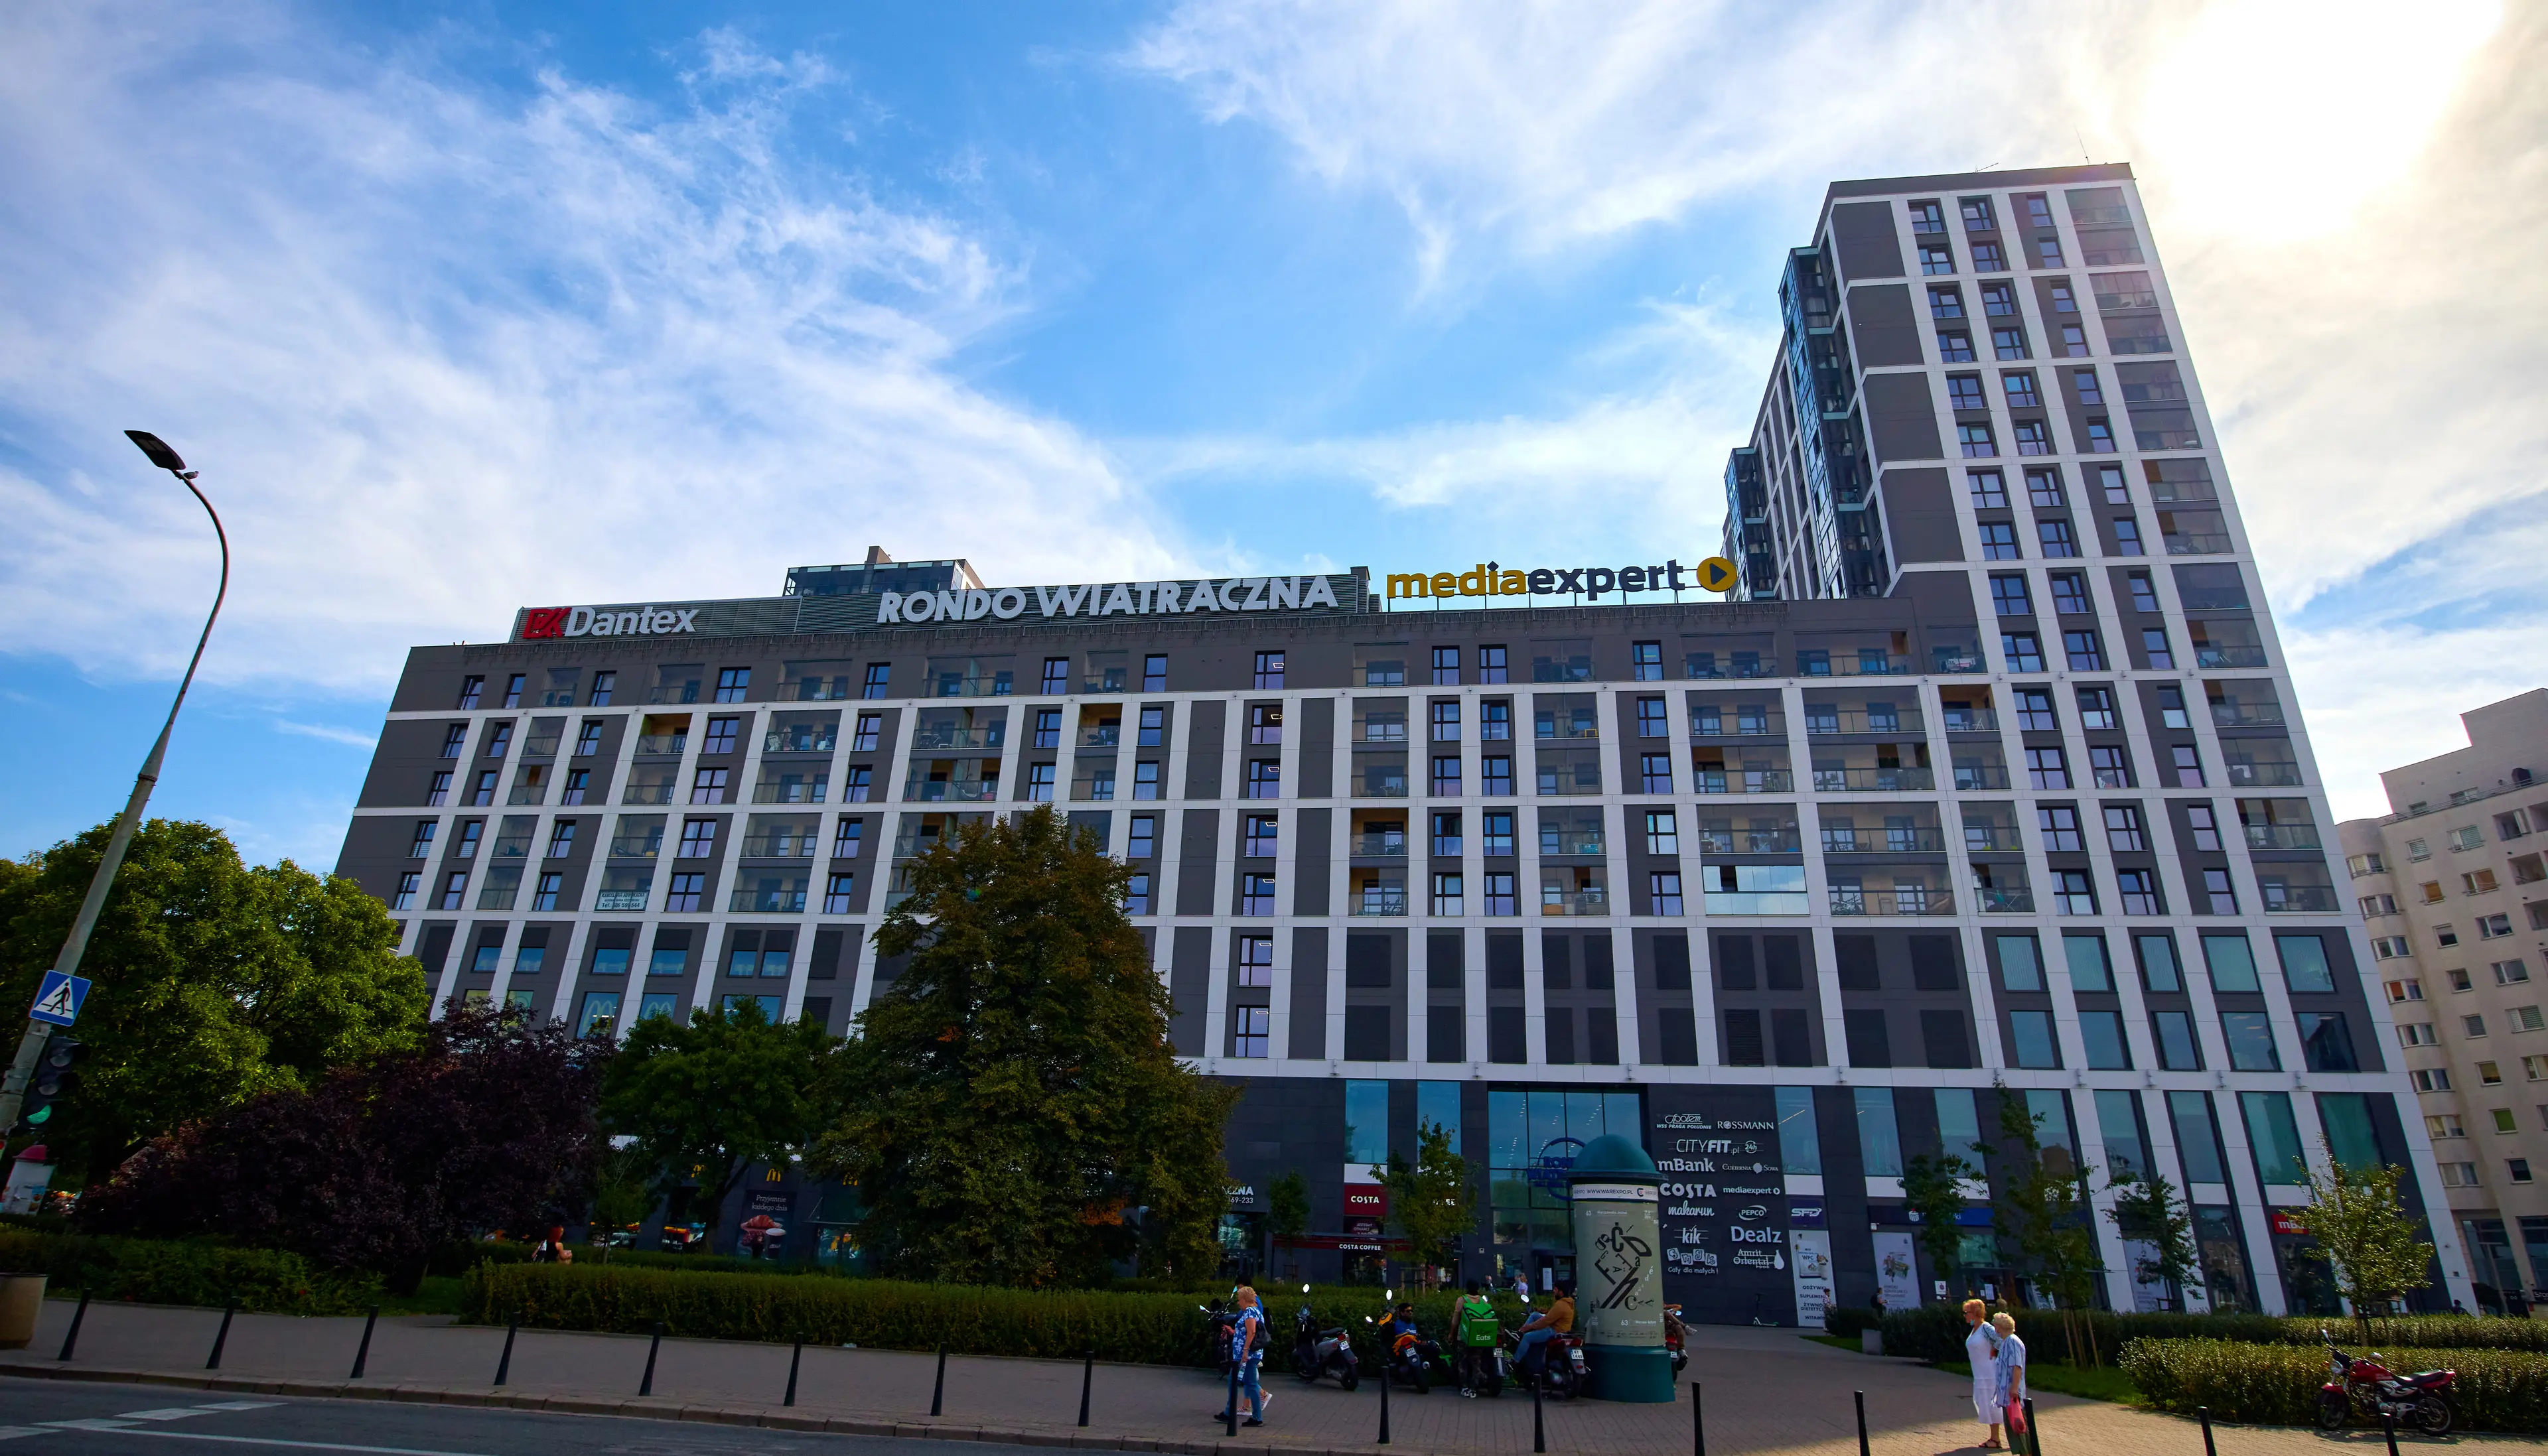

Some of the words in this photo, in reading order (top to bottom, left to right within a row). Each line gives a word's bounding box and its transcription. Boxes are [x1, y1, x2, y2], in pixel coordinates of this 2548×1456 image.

[1386, 559, 1685, 600] mediaexpert
[877, 587, 1027, 625] RONDO
[1034, 575, 1340, 617] WIATRACZNA
[565, 606, 700, 637] Dantex
[1717, 1120, 1774, 1130] ROSSMANN
[1658, 1158, 1715, 1172] mBank
[1660, 1183, 1717, 1199] COSTA
[1723, 1186, 1772, 1195] mediaexpert
[756, 1194, 787, 1203] Przyjemnie
[1351, 1195, 1380, 1204] COSTA
[1668, 1200, 1715, 1217] makarun
[1740, 1209, 1765, 1217] PEPCO
[1731, 1226, 1782, 1243] Dealz
